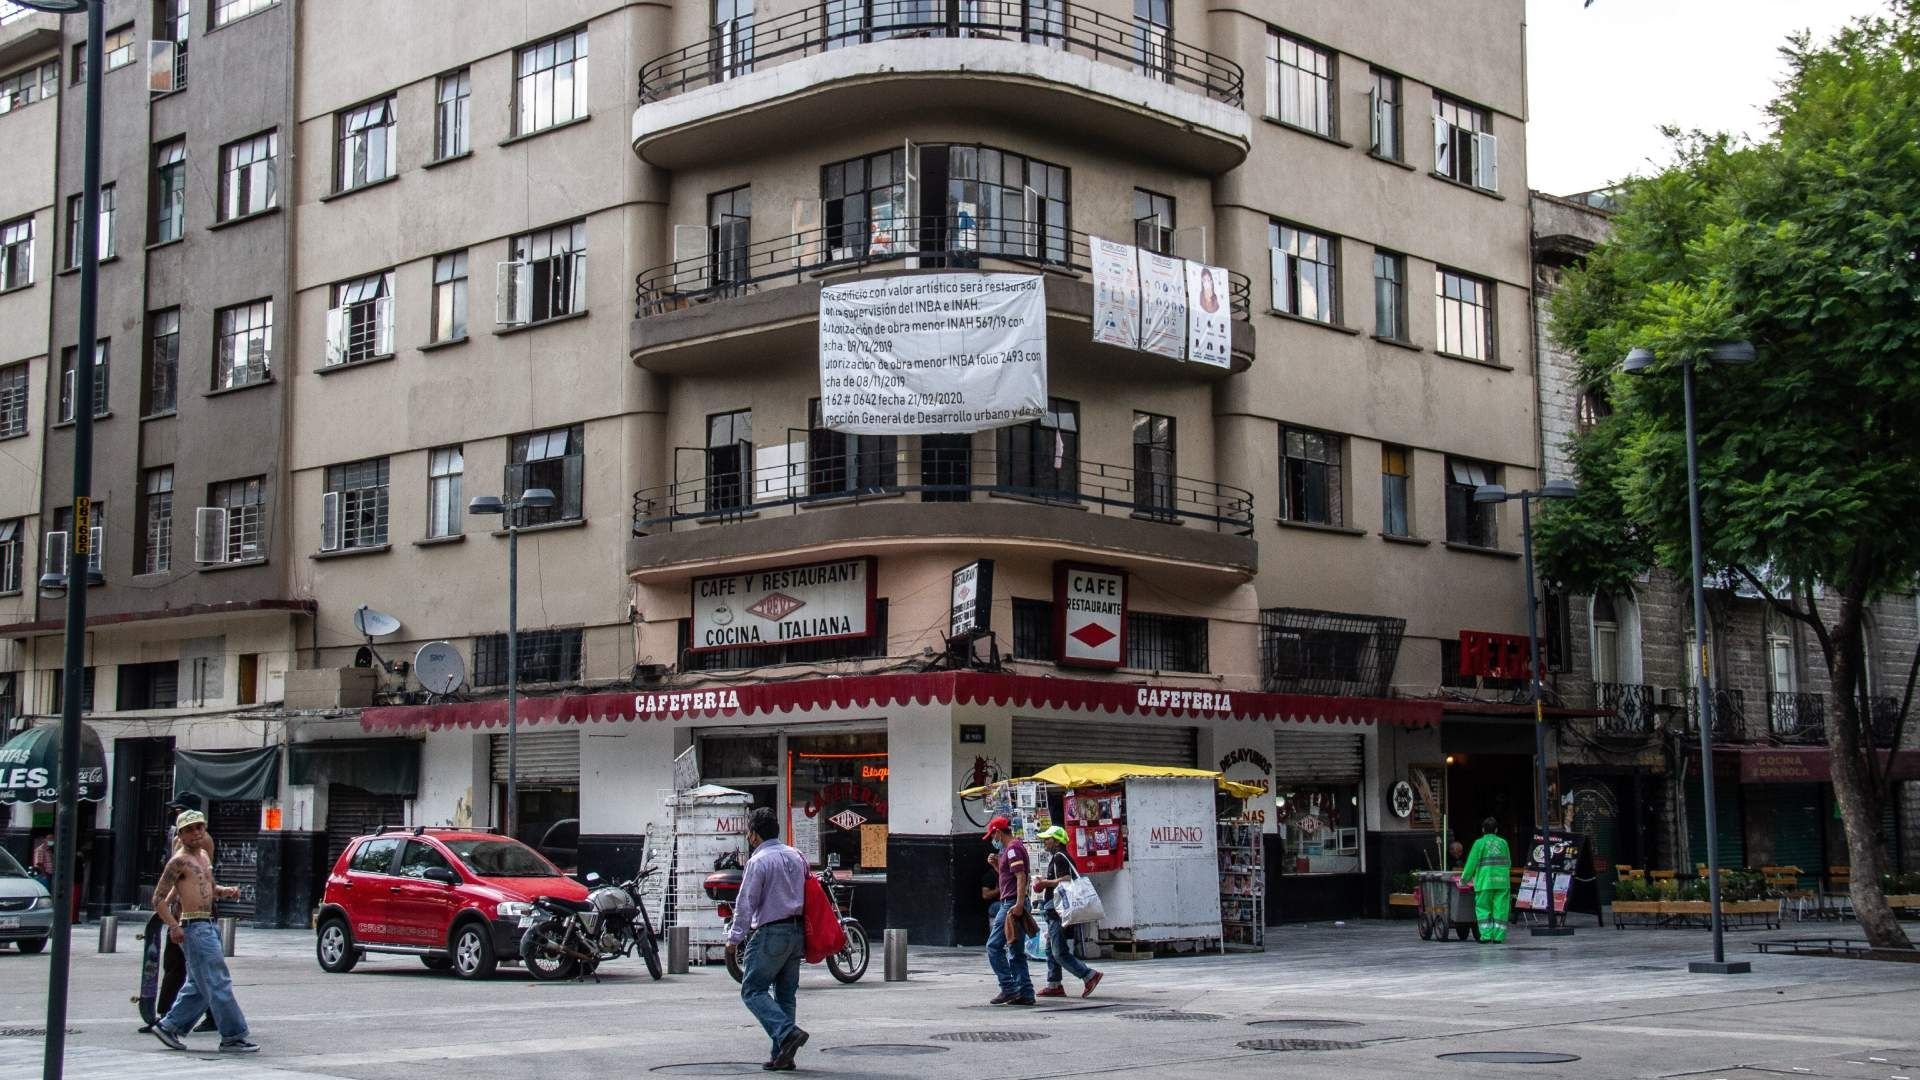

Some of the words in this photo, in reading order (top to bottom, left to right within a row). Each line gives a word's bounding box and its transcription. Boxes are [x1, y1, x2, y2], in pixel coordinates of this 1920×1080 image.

[870, 288, 886, 299] con
[888, 284, 913, 296] valor
[915, 280, 958, 294] artístico
[960, 280, 983, 293] será
[844, 302, 897, 320] supervisión
[898, 302, 914, 314] del
[915, 300, 942, 313] INBA
[943, 302, 950, 311] e
[875, 323, 886, 335] de
[887, 321, 910, 334] obra
[912, 320, 945, 333] menor
[947, 316, 974, 329] INAH
[976, 315, 1007, 331] 567/19
[1008, 317, 1025, 328] con
[825, 357, 878, 370] utorización
[878, 358, 889, 370] de
[890, 357, 913, 370] obra
[914, 358, 947, 369] menor
[949, 354, 975, 368] INBA
[976, 353, 999, 366] folio
[1001, 350, 1024, 364] 2493
[1025, 352, 1041, 362] con
[842, 375, 855, 388] de
[856, 375, 905, 389] 08/11/2019
[853, 393, 877, 406] 0642
[879, 392, 906, 406] fecha
[862, 411, 901, 424] General
[903, 411, 915, 424] de
[917, 410, 972, 424] Desarrollo
[974, 408, 1010, 421] urbano
[1011, 410, 1018, 419] y
[701, 578, 737, 598] CAFE
[745, 575, 755, 593] Y
[762, 563, 859, 592] RESTAURANT
[1073, 576, 1117, 597] CAFE
[1067, 597, 1122, 616] RESTAURANTE
[706, 625, 761, 646] COCINA
[778, 616, 852, 640] ITALIANA
[635, 690, 740, 713] CAFETERIA
[1137, 688, 1232, 712] CAFETERIA
[1150, 826, 1203, 842] MILENIO
